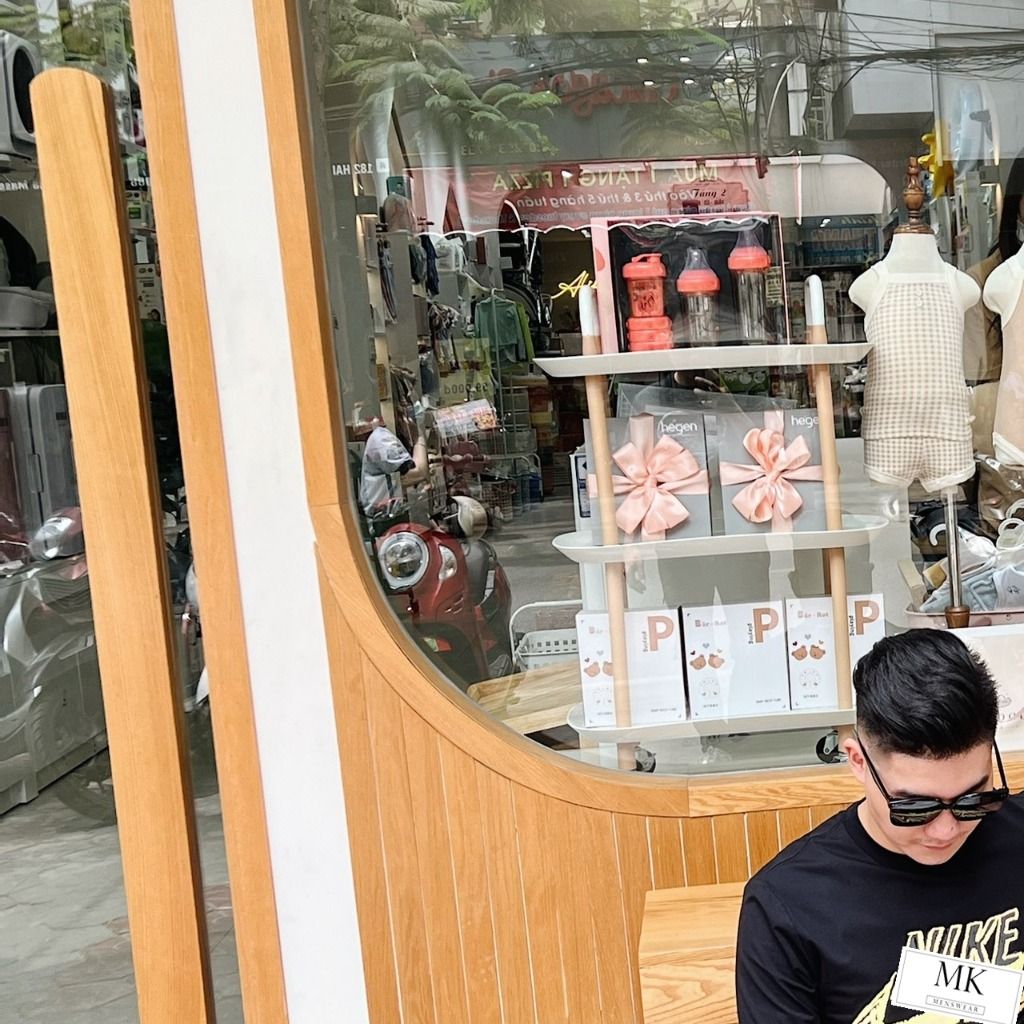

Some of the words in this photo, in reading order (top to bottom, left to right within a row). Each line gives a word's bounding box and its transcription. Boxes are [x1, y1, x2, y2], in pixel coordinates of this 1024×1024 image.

[661, 421, 697, 435] hegen
[791, 415, 819, 427] hege
[648, 615, 674, 651] P
[753, 608, 779, 643] P
[855, 600, 880, 635] P
